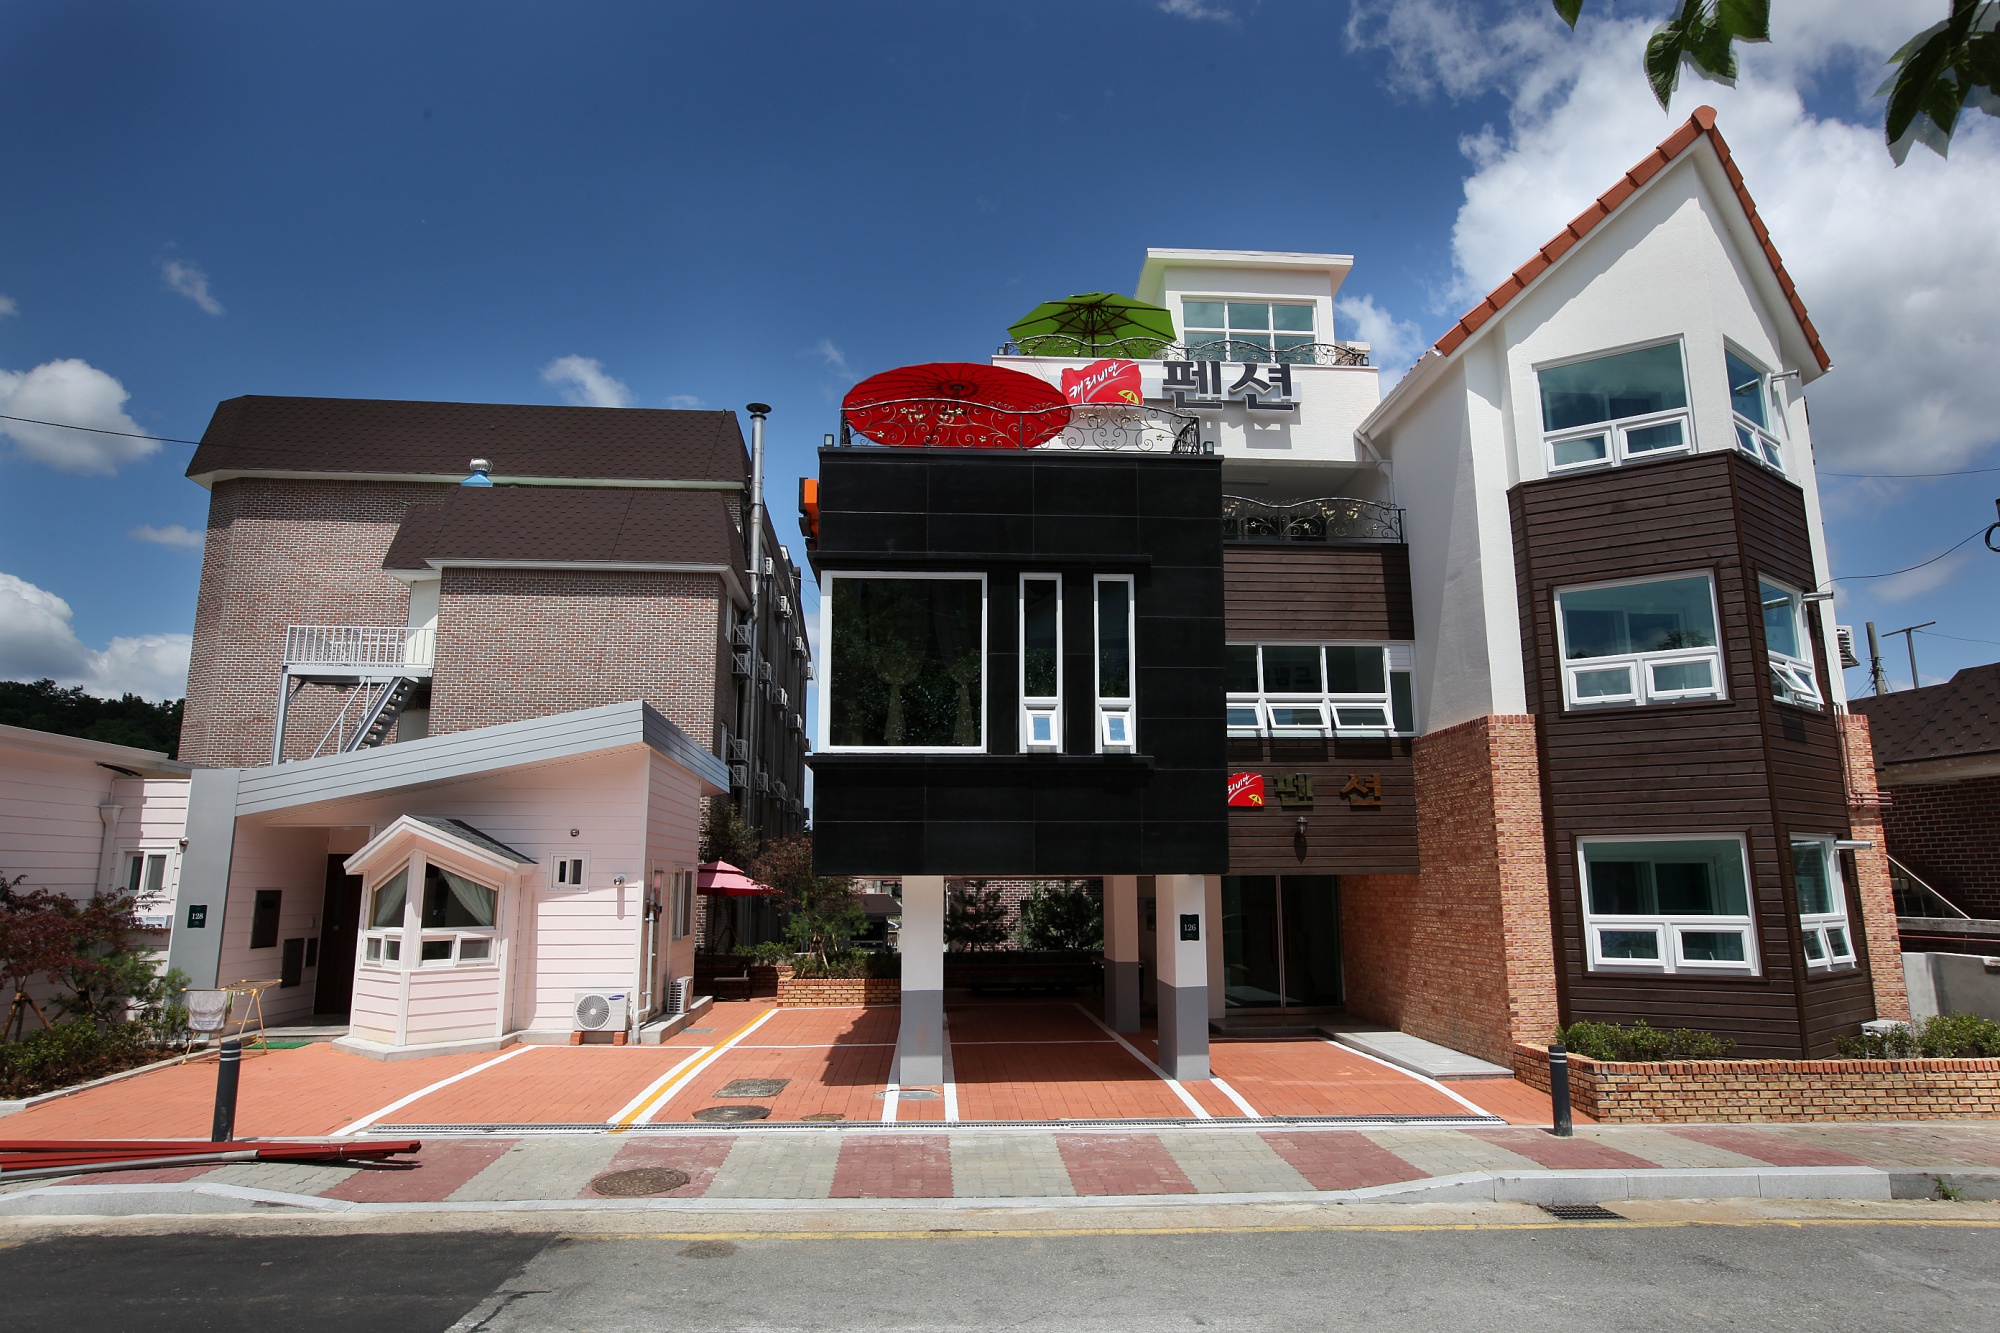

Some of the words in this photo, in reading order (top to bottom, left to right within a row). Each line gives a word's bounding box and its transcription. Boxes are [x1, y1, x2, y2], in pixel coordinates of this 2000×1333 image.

[1068, 361, 1137, 404] 캐리비안
[1162, 360, 1295, 412] 펜션
[1273, 772, 1382, 810] 펜션
[191, 912, 204, 920] 128
[1183, 923, 1197, 932] 126
